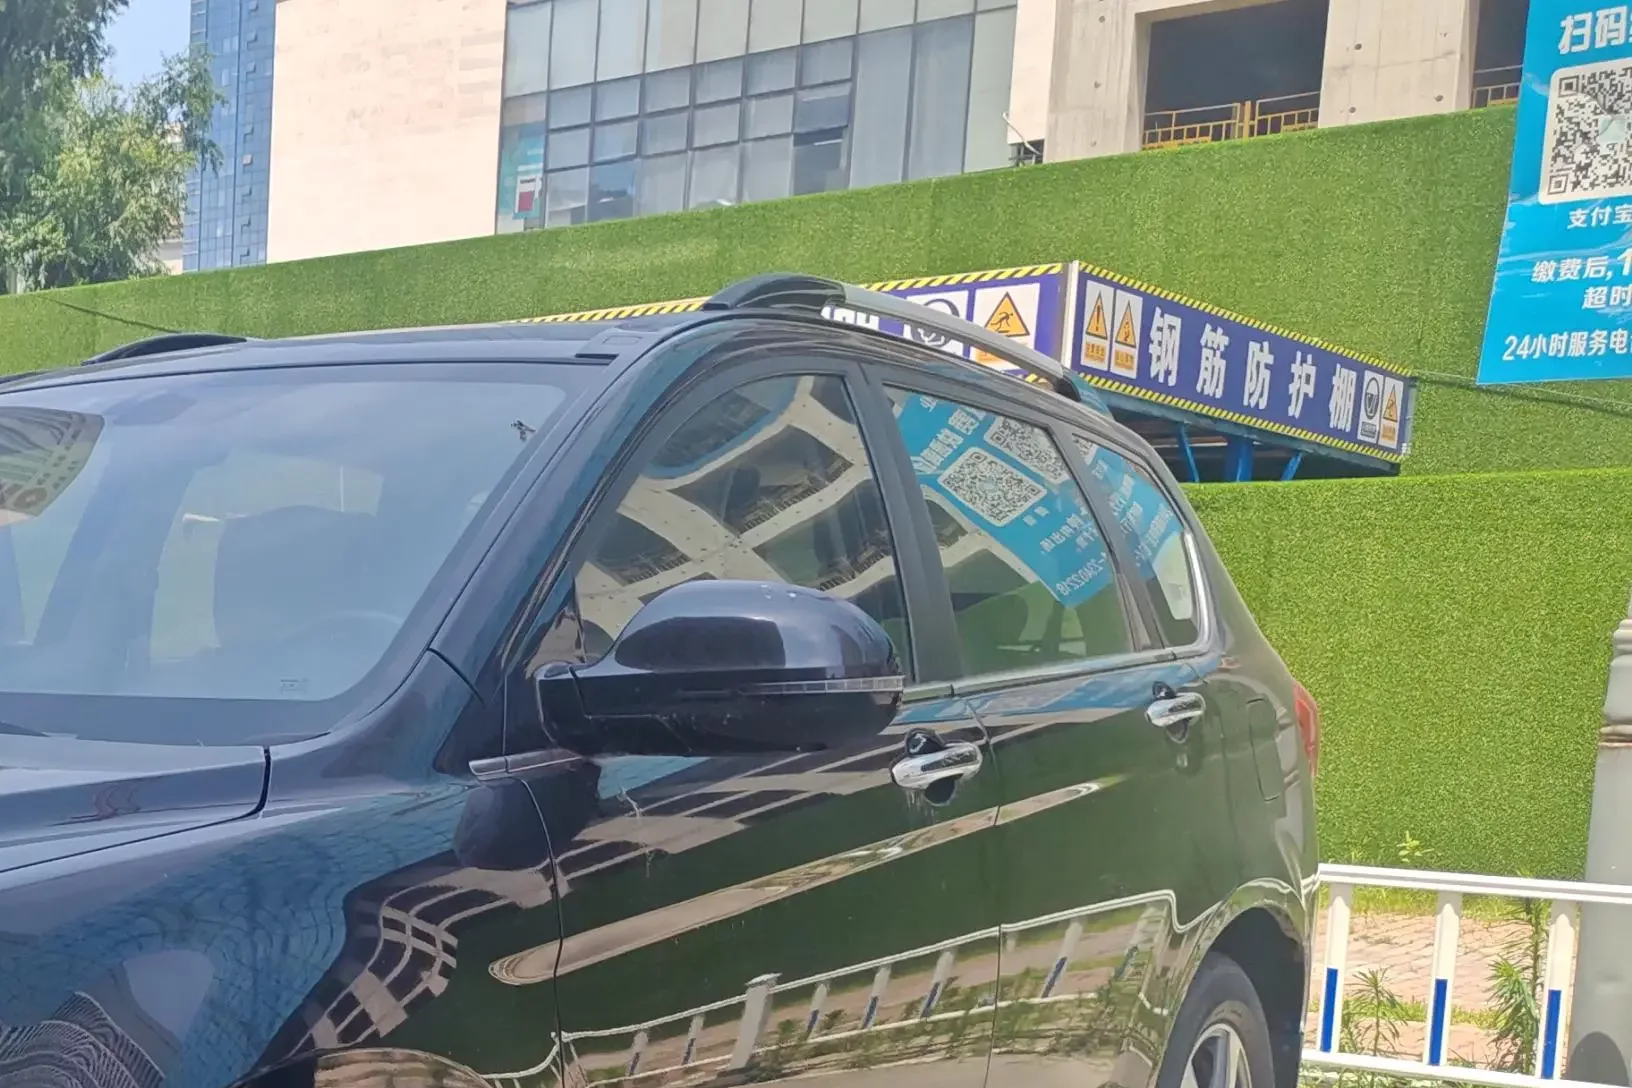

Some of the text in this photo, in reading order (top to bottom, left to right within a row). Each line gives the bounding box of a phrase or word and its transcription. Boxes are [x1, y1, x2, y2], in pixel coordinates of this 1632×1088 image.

[1558, 5, 1632, 55] 扫码
[1567, 204, 1632, 229] 支付宝
[1581, 284, 1632, 309] 超时
[1502, 327, 1632, 361] 24小时服务电
[1148, 306, 1358, 432] 钢筋防护棚
